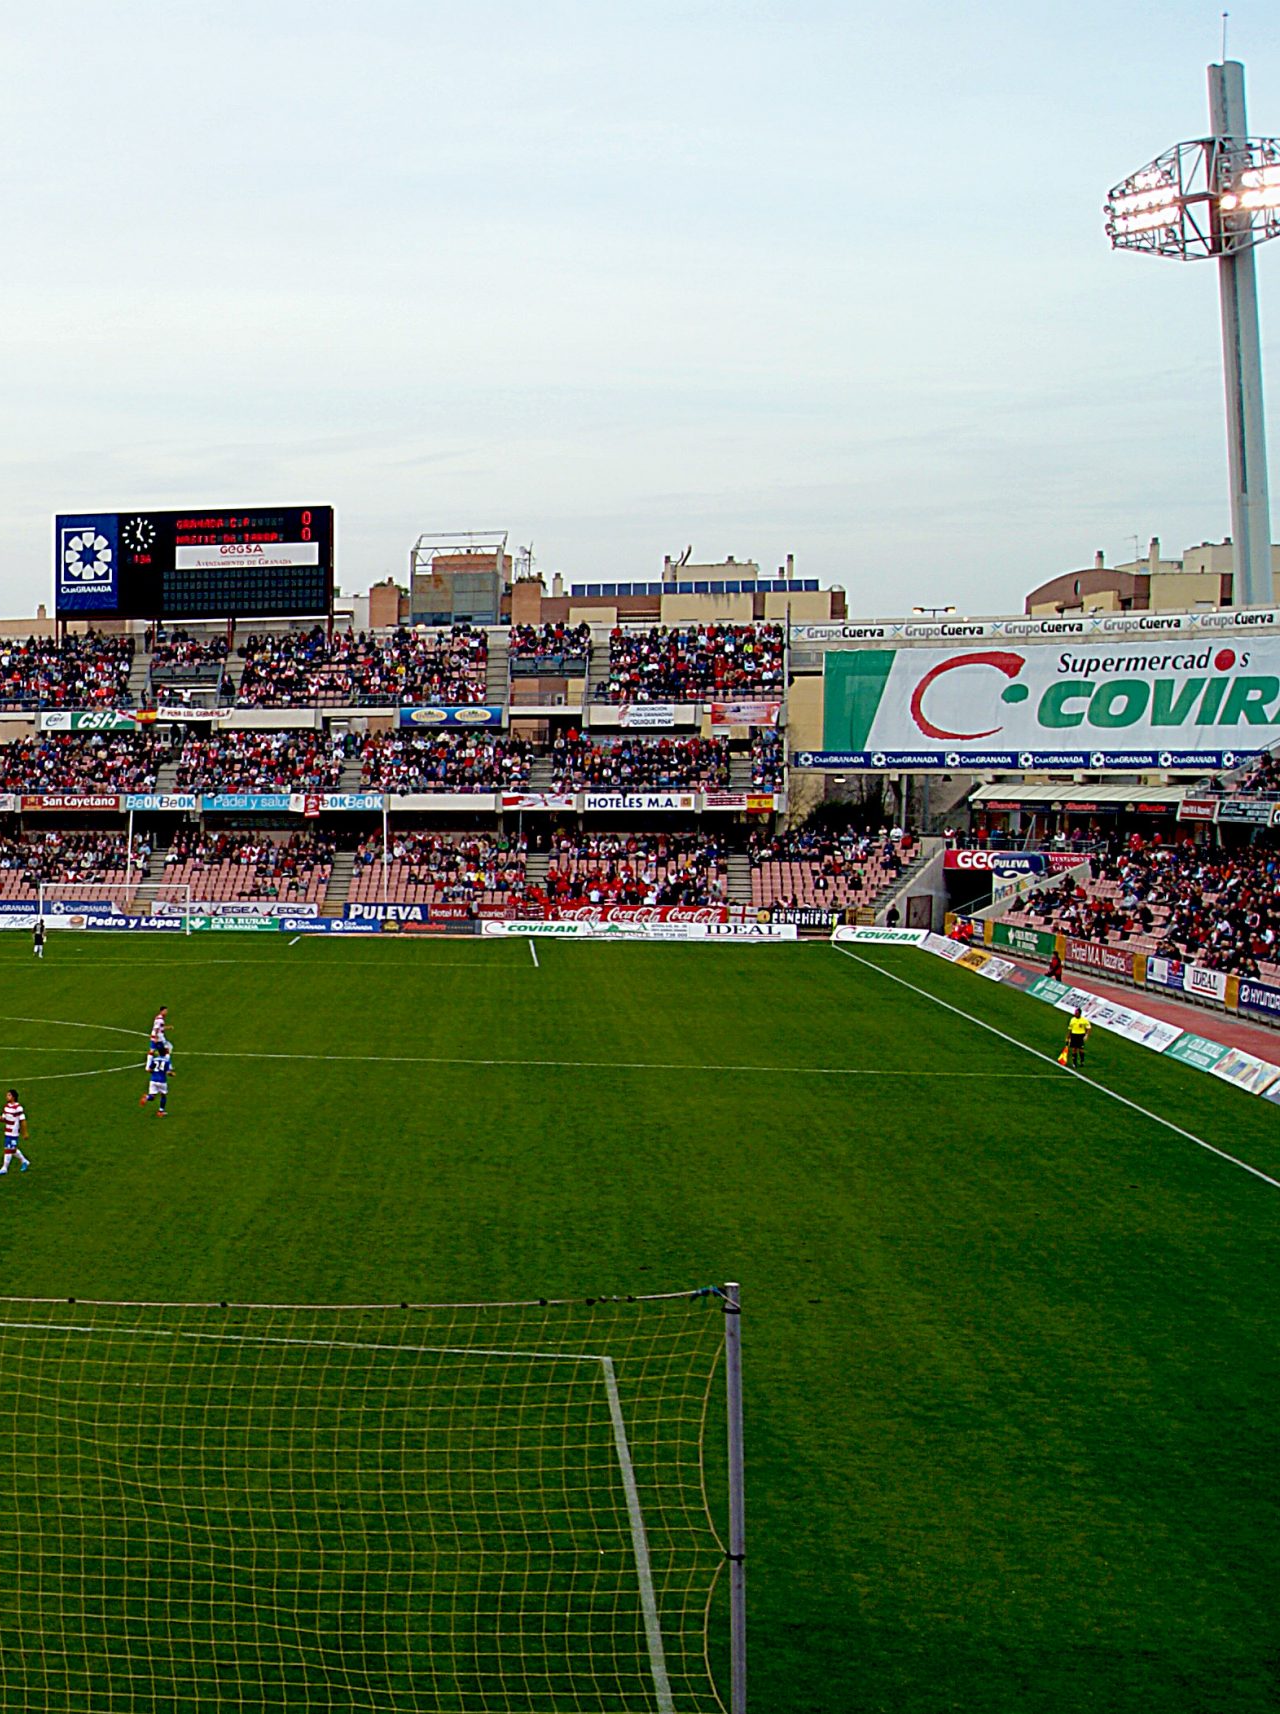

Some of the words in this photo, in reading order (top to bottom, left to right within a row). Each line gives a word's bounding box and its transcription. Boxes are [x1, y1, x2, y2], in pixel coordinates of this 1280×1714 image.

[302, 511, 311, 525] 0
[302, 527, 311, 541] 0
[1038, 676, 1280, 728] COVIR
[42, 796, 63, 806] San
[64, 796, 116, 808] Cayetano
[250, 799, 258, 809] y
[587, 797, 643, 808] HOTELES
[647, 797, 678, 808] M.A.
[993, 859, 1030, 869] PULEVA
[222, 906, 260, 914] EGEA
[277, 907, 315, 915] EGEA
[349, 904, 423, 920] PULEVA
[431, 908, 452, 917] Hotel
[88, 916, 125, 926] Pedro
[129, 919, 138, 928] y
[140, 916, 181, 928] López
[211, 917, 235, 925] CAJA
[507, 924, 579, 933] COVIRAN
[705, 925, 781, 935] IDEAL
[856, 931, 921, 942] COVIRAN
[1192, 969, 1218, 990] IDEAL
[154, 1061, 166, 1072] 24
